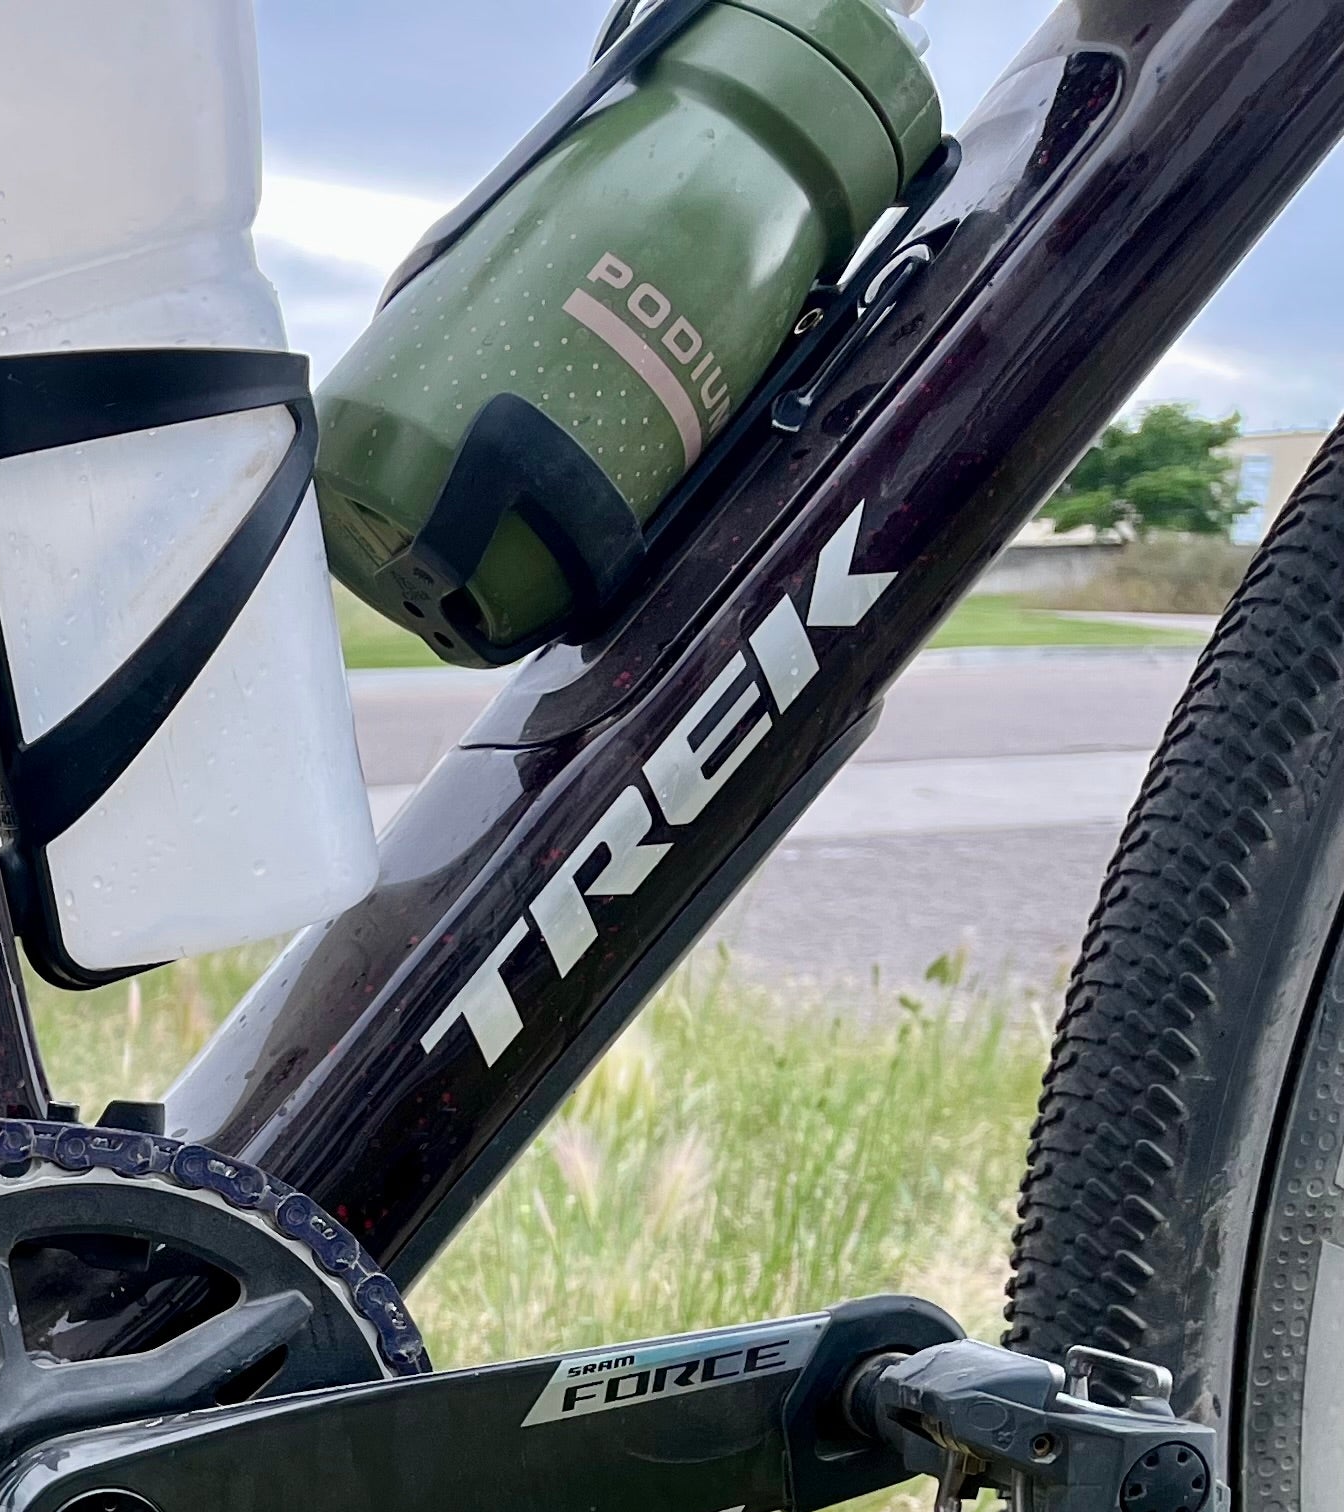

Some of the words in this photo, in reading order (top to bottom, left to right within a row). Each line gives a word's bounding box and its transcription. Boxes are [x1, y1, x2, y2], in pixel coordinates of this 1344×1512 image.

[420, 498, 898, 1068] TREK
[561, 1338, 791, 1413] FORCE
[567, 1354, 635, 1378] SRAM
